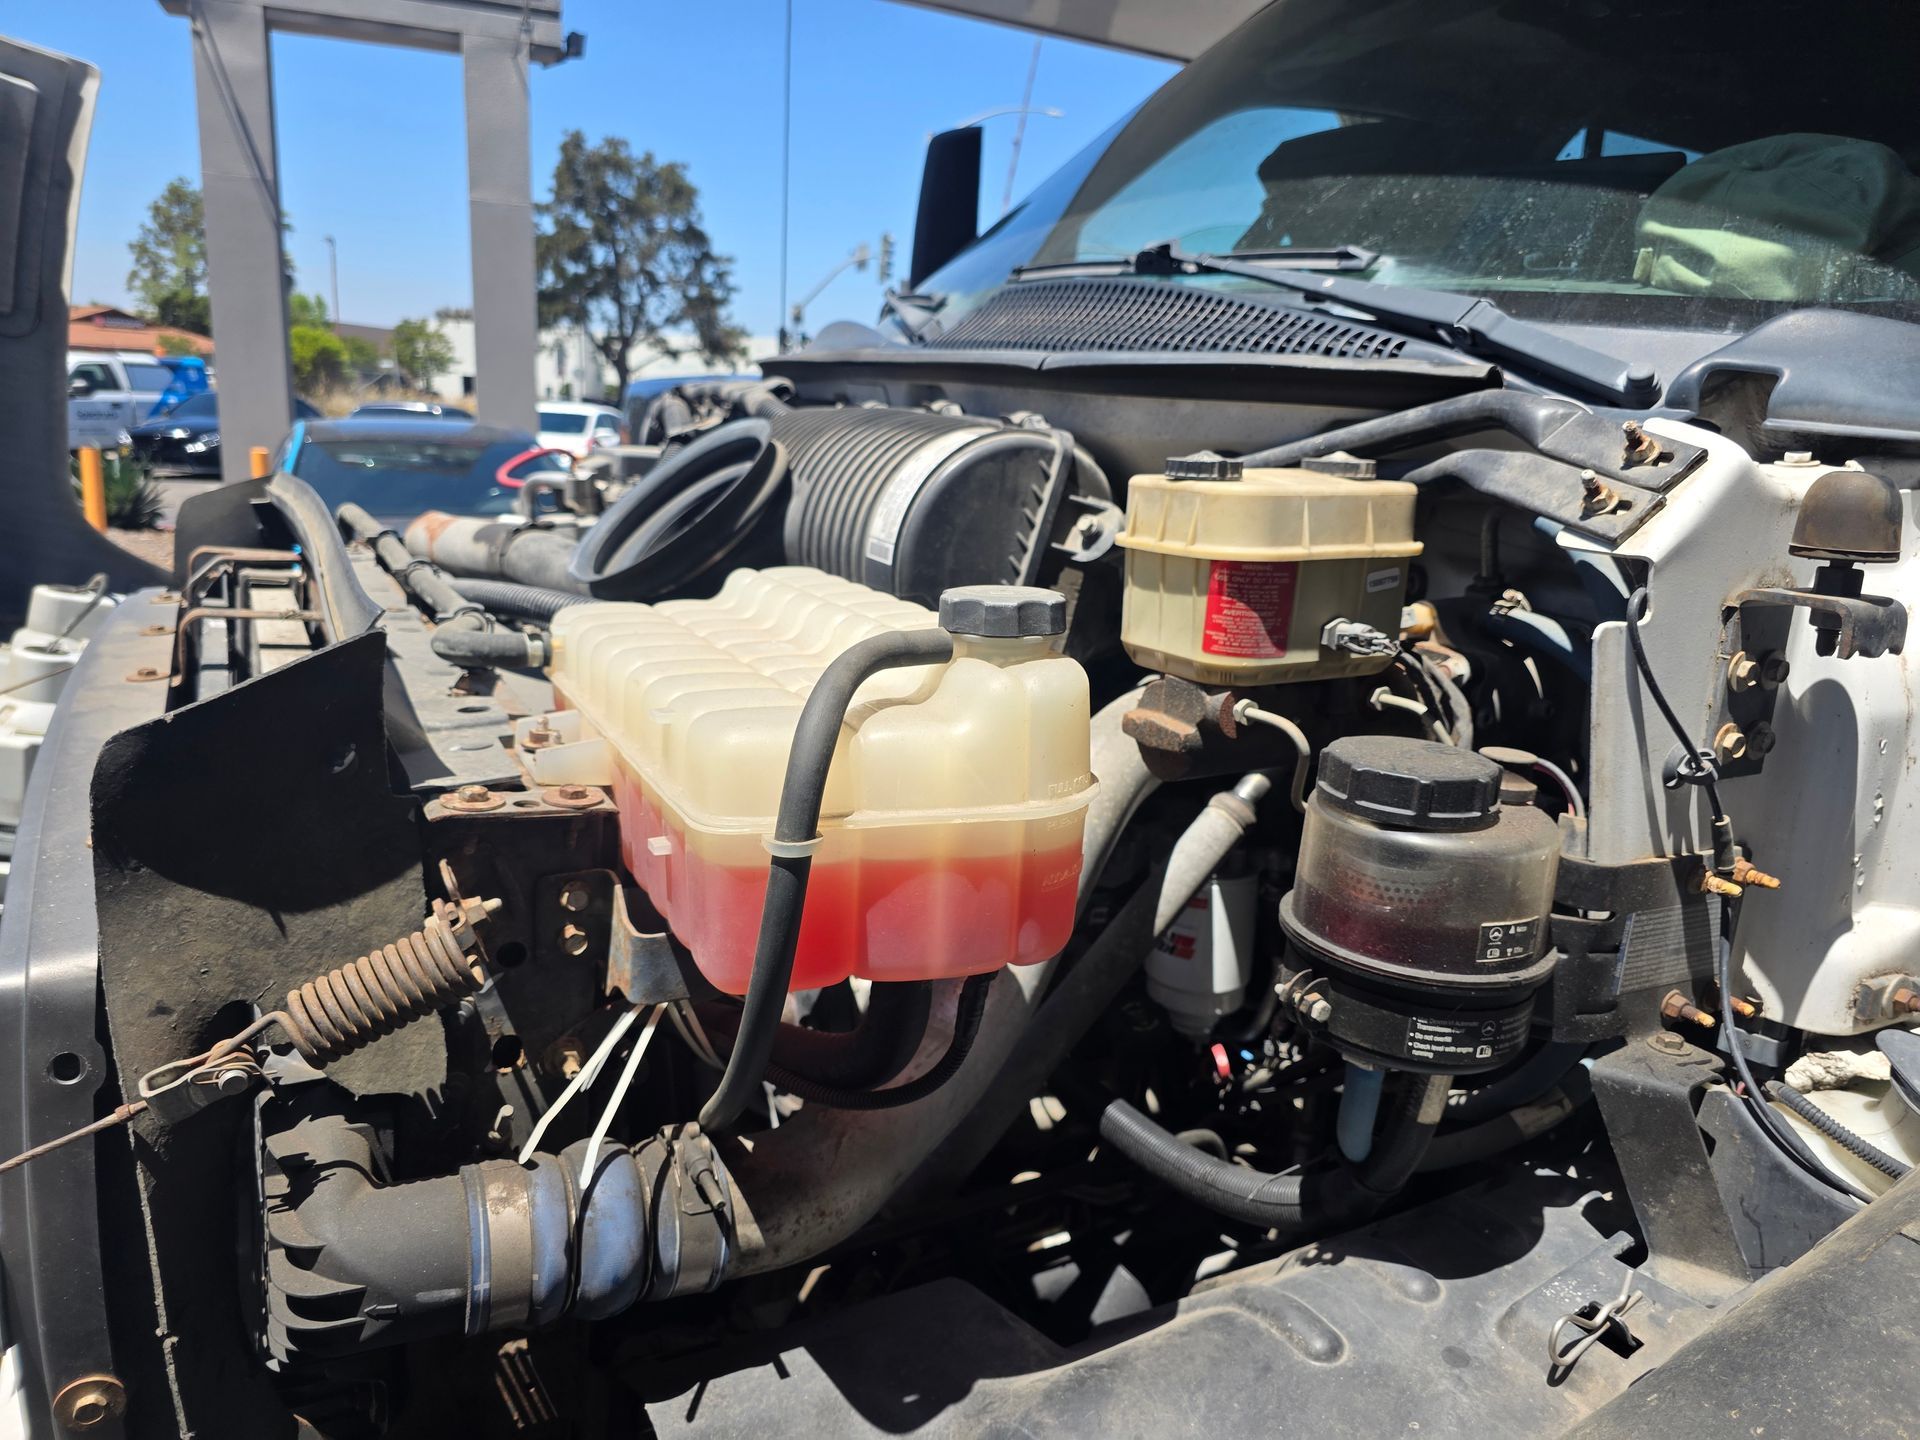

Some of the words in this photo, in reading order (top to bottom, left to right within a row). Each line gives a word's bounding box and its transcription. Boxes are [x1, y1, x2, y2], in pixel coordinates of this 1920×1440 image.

[1415, 1032, 1423, 1040] Do
[1424, 1034, 1433, 1042] not
[1413, 1041, 1430, 1051] Check
[1431, 1044, 1443, 1052] level
